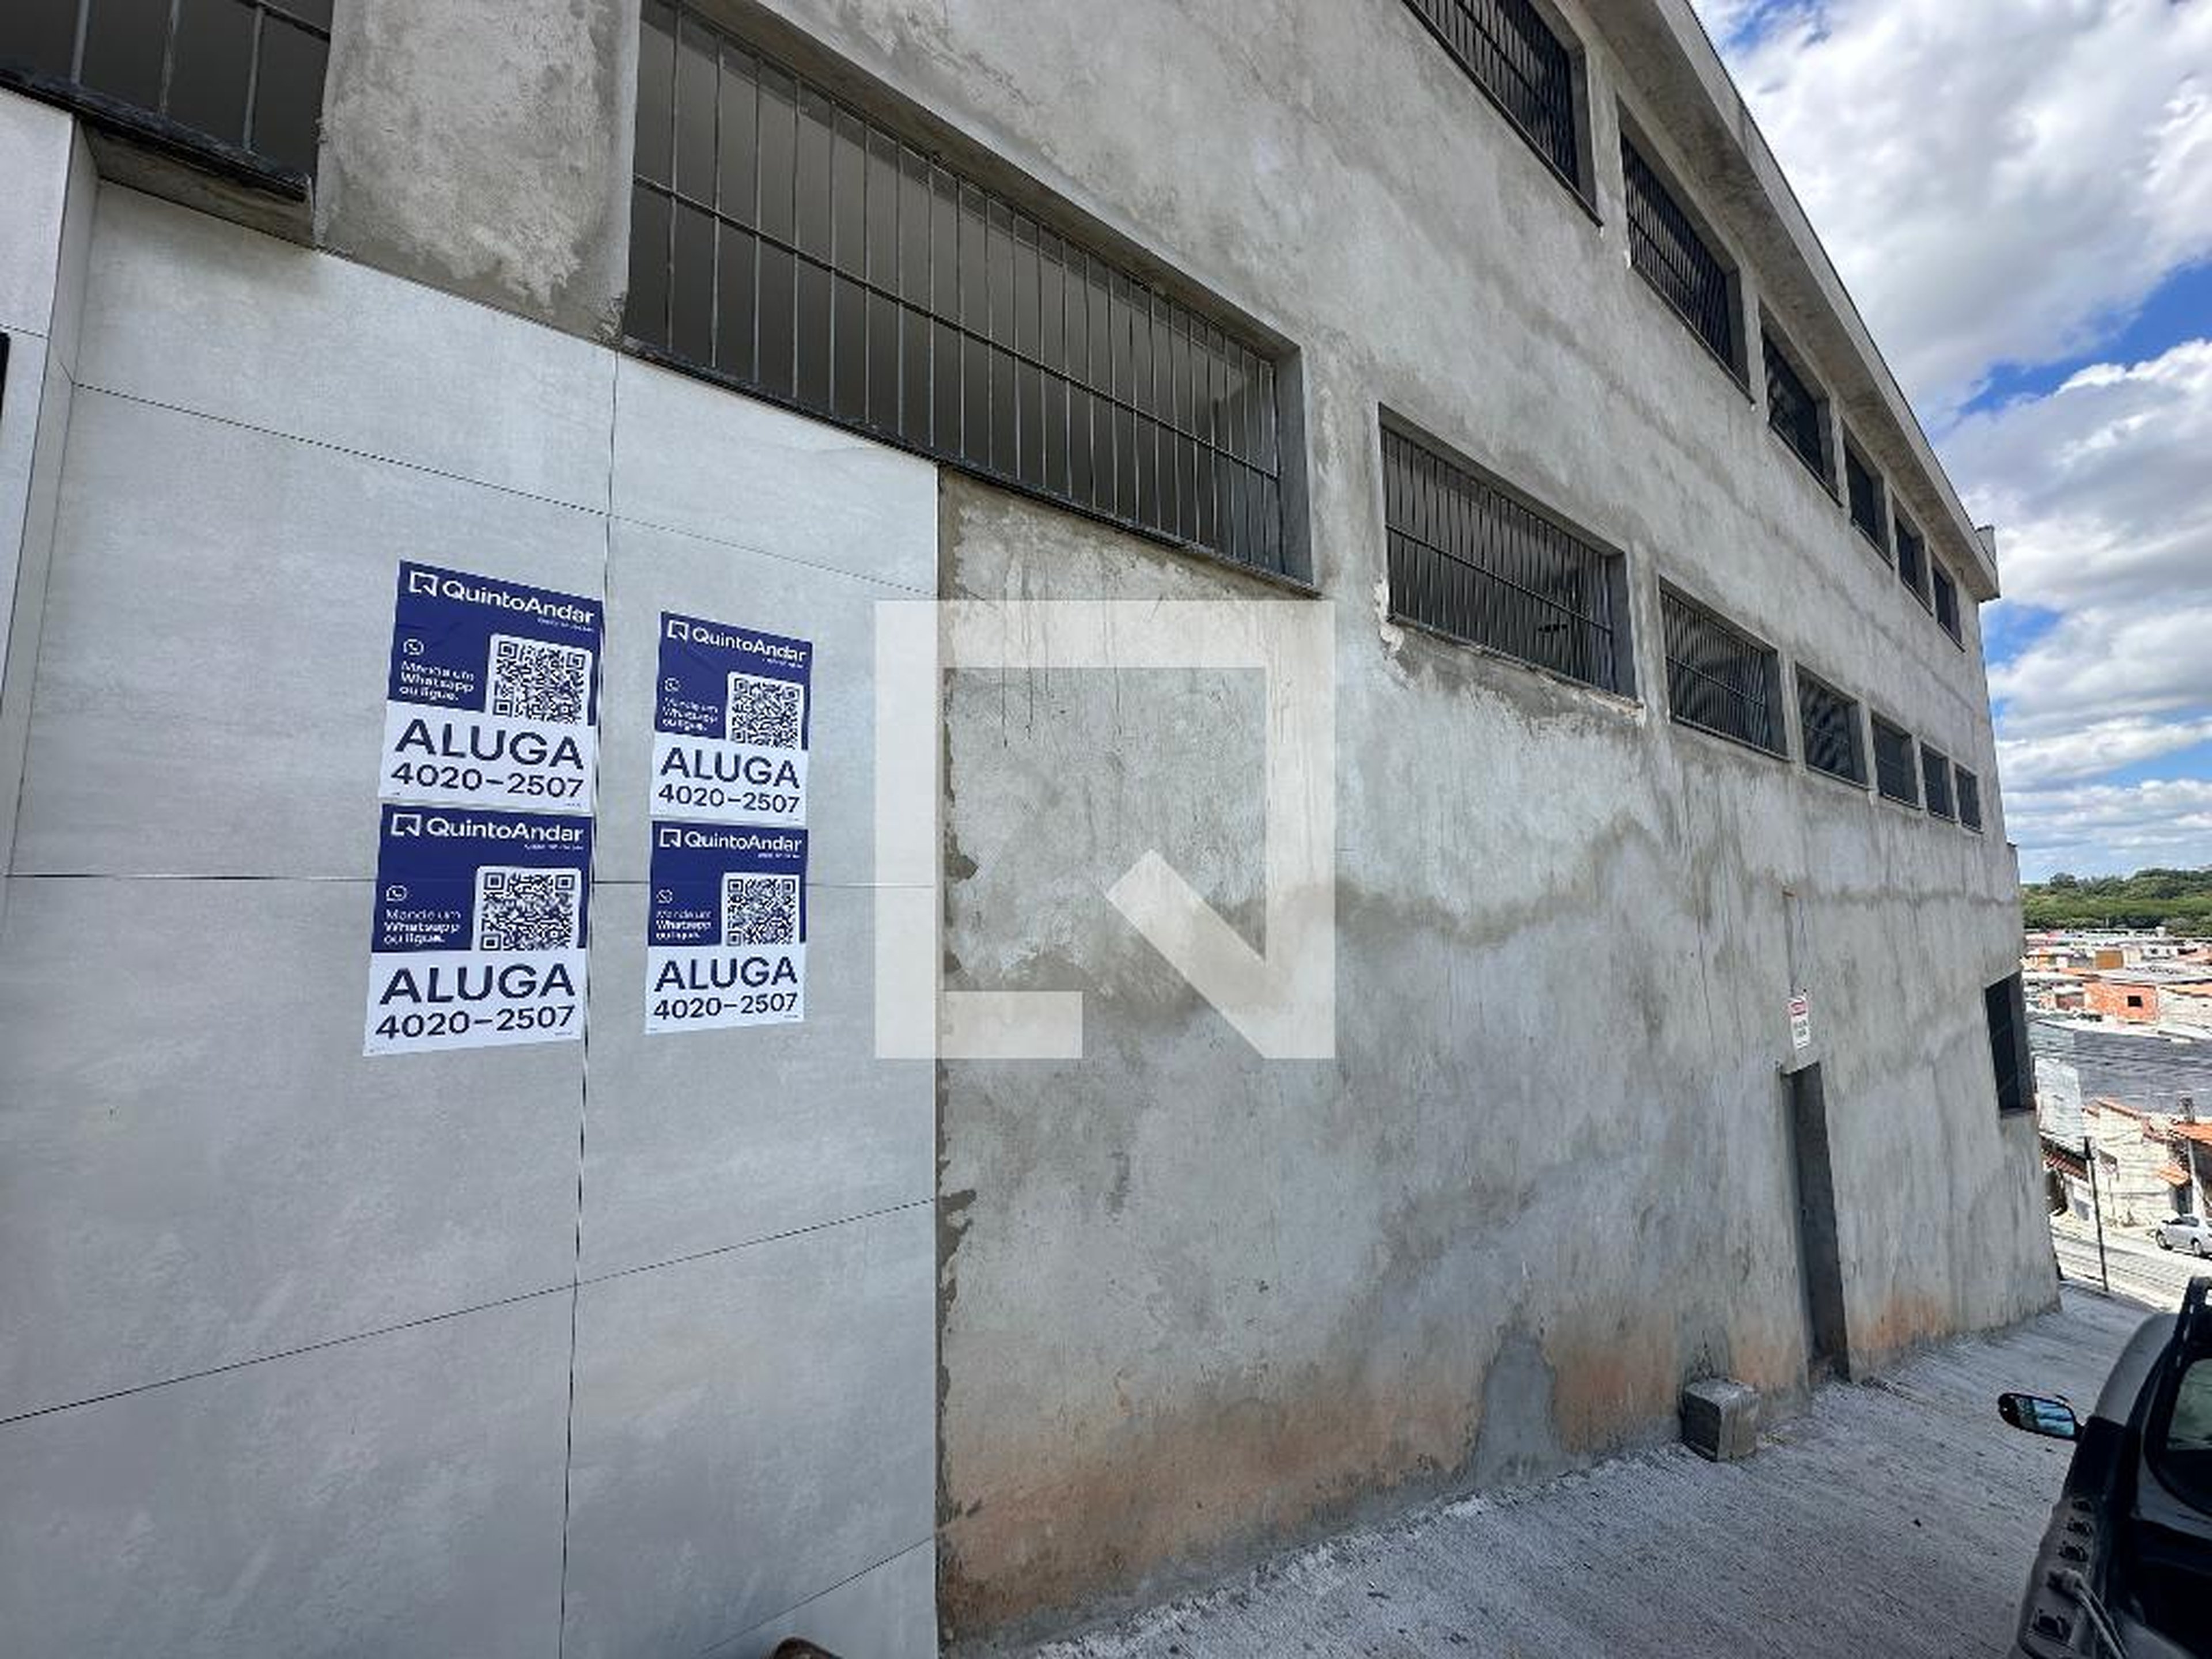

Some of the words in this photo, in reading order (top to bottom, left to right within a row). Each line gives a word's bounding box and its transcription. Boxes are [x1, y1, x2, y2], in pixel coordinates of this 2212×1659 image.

[442, 580, 594, 623] QuintoAndar
[692, 627, 806, 662] QuintoAndar
[395, 718, 584, 770] ALUGA
[391, 763, 584, 797] 4020-2507
[660, 747, 800, 789] ALUGA
[658, 784, 800, 813] 4020-2507
[427, 817, 584, 842] QuintoAndar
[684, 831, 801, 851] QuintoAndar
[380, 963, 575, 1005] ALUGA
[654, 956, 798, 992] ALUGA
[376, 1005, 575, 1039] 4020-2507
[654, 993, 798, 1020] 4020-2507
